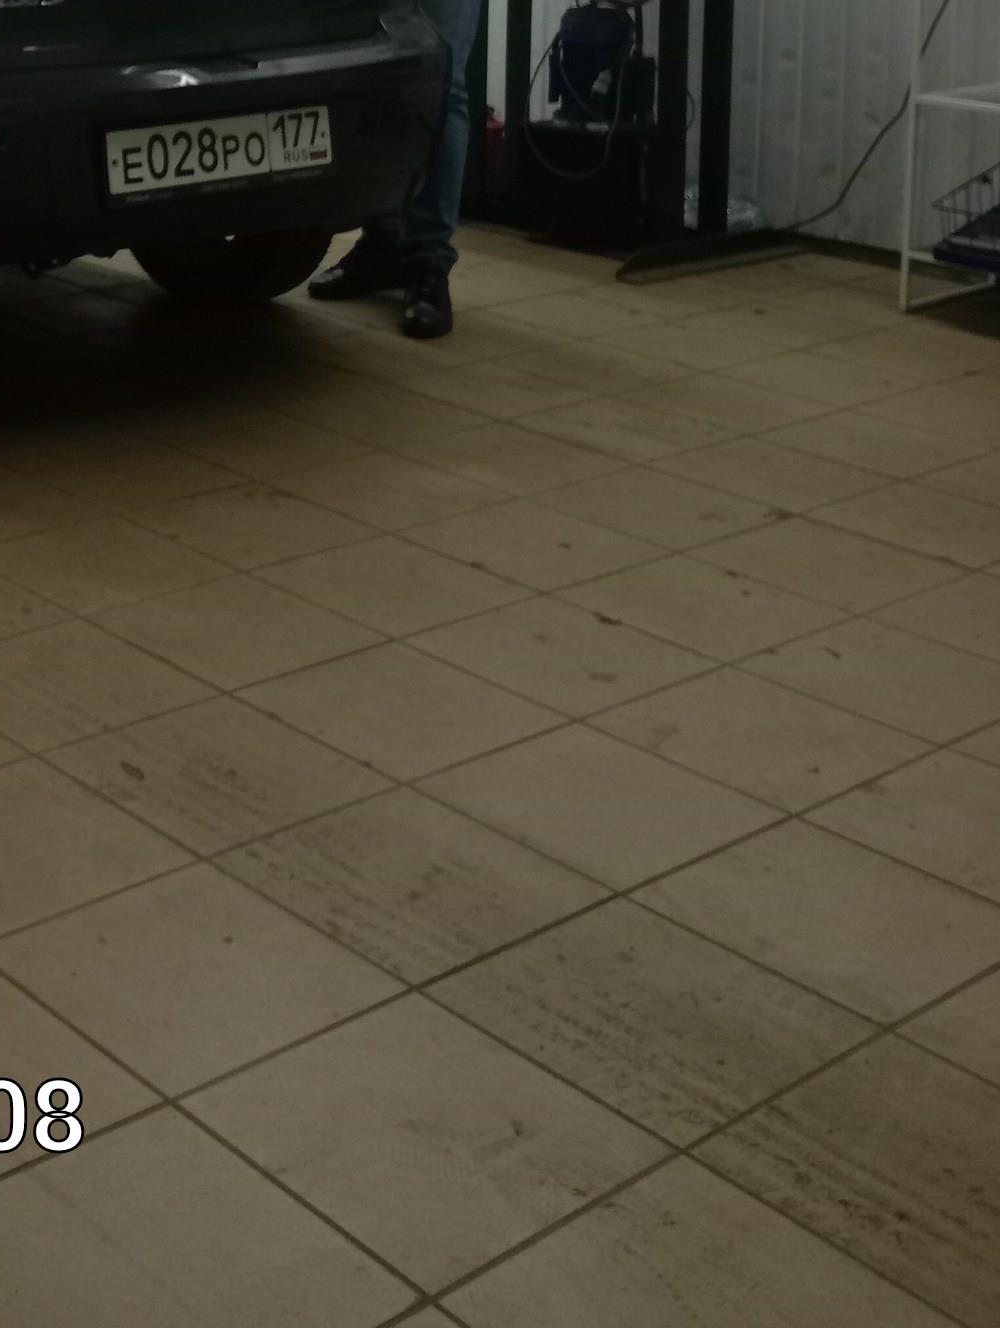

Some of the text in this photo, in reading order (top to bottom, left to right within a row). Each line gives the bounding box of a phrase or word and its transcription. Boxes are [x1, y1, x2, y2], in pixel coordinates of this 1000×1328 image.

[120, 110, 320, 185] E028PO 177
[283, 149, 309, 163] RUS
